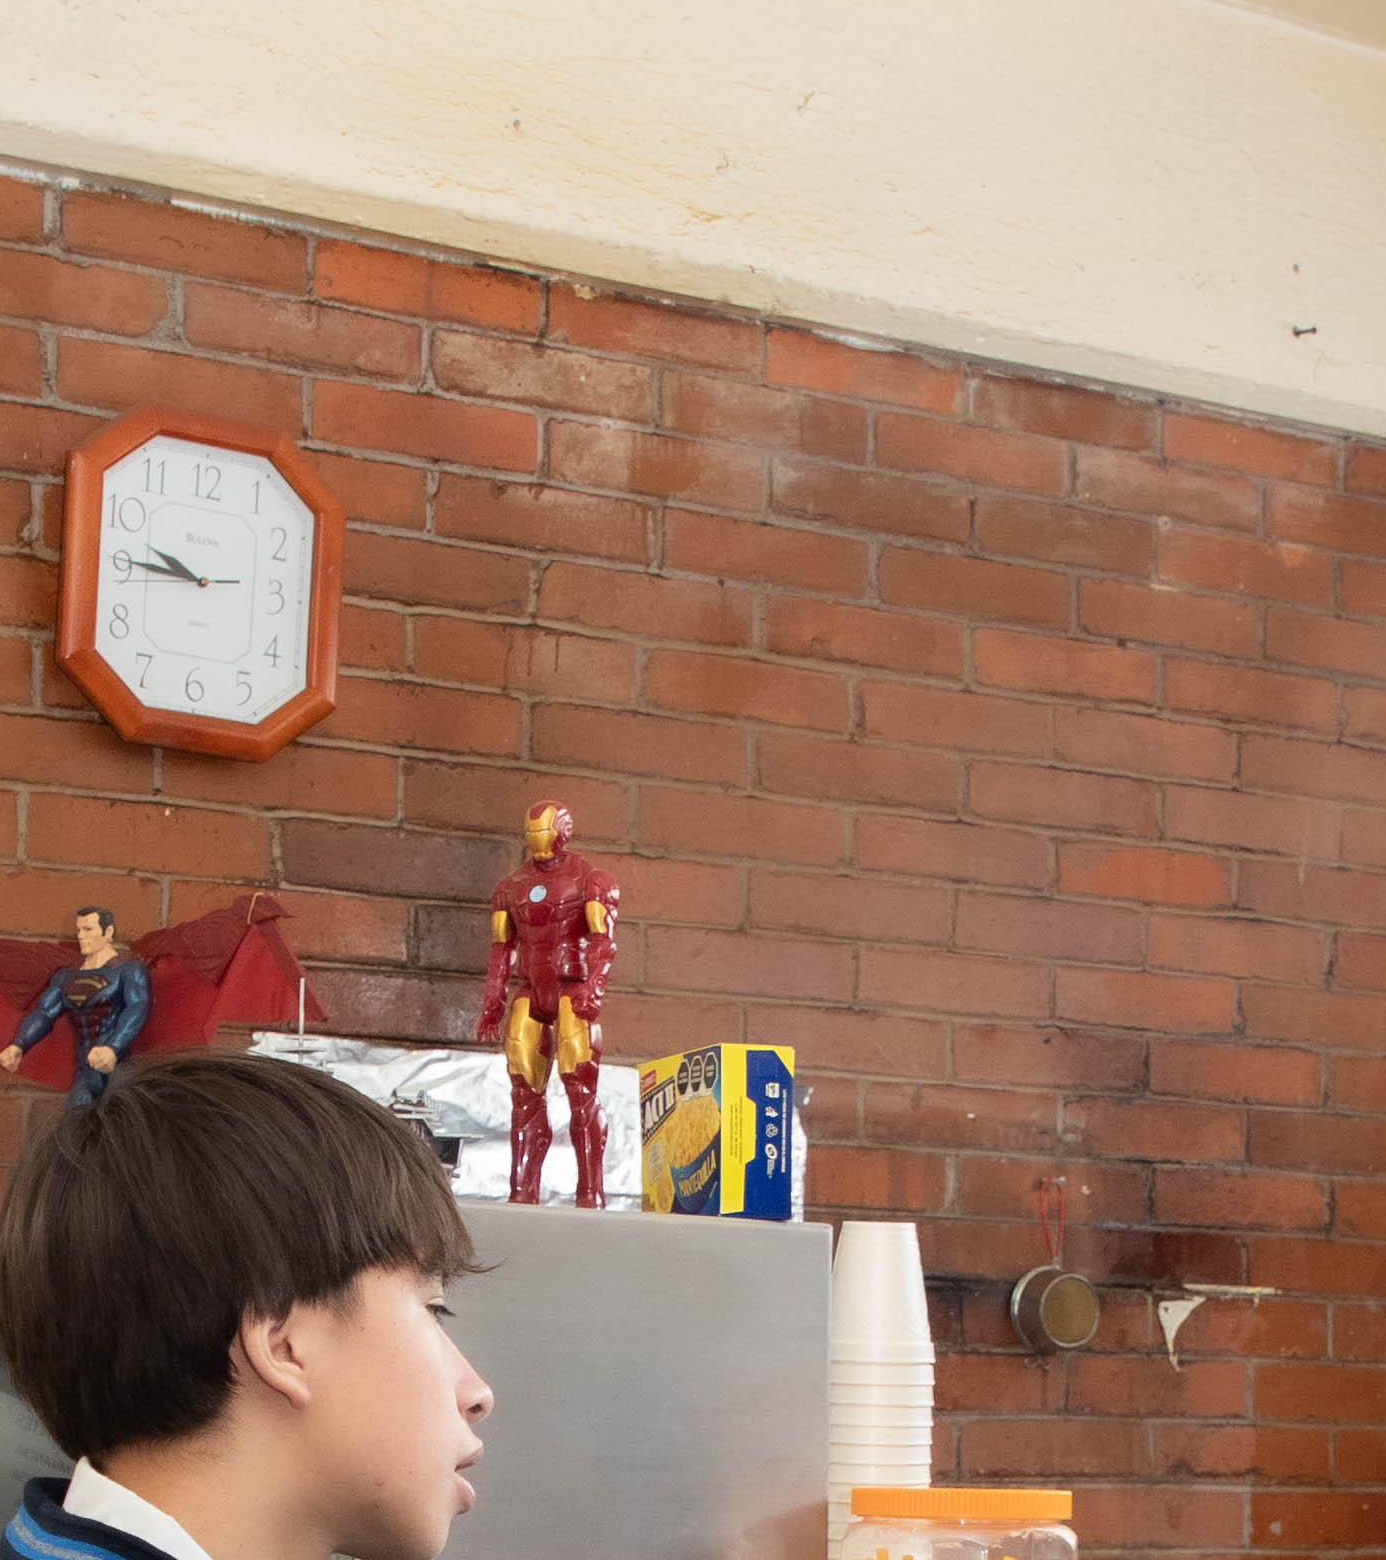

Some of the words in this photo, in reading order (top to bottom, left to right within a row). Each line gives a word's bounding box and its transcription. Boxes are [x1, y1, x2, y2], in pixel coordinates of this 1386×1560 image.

[142, 458, 167, 496] 11
[191, 463, 222, 501] 12
[107, 493, 146, 533] 10
[251, 480, 262, 515] 1
[270, 527, 287, 562] 2
[113, 549, 132, 584] 9
[265, 579, 285, 615] 3
[109, 603, 130, 640] 8
[264, 634, 281, 668] 4
[136, 652, 153, 689] 7
[185, 667, 204, 703] 6
[236, 670, 252, 706] 5
